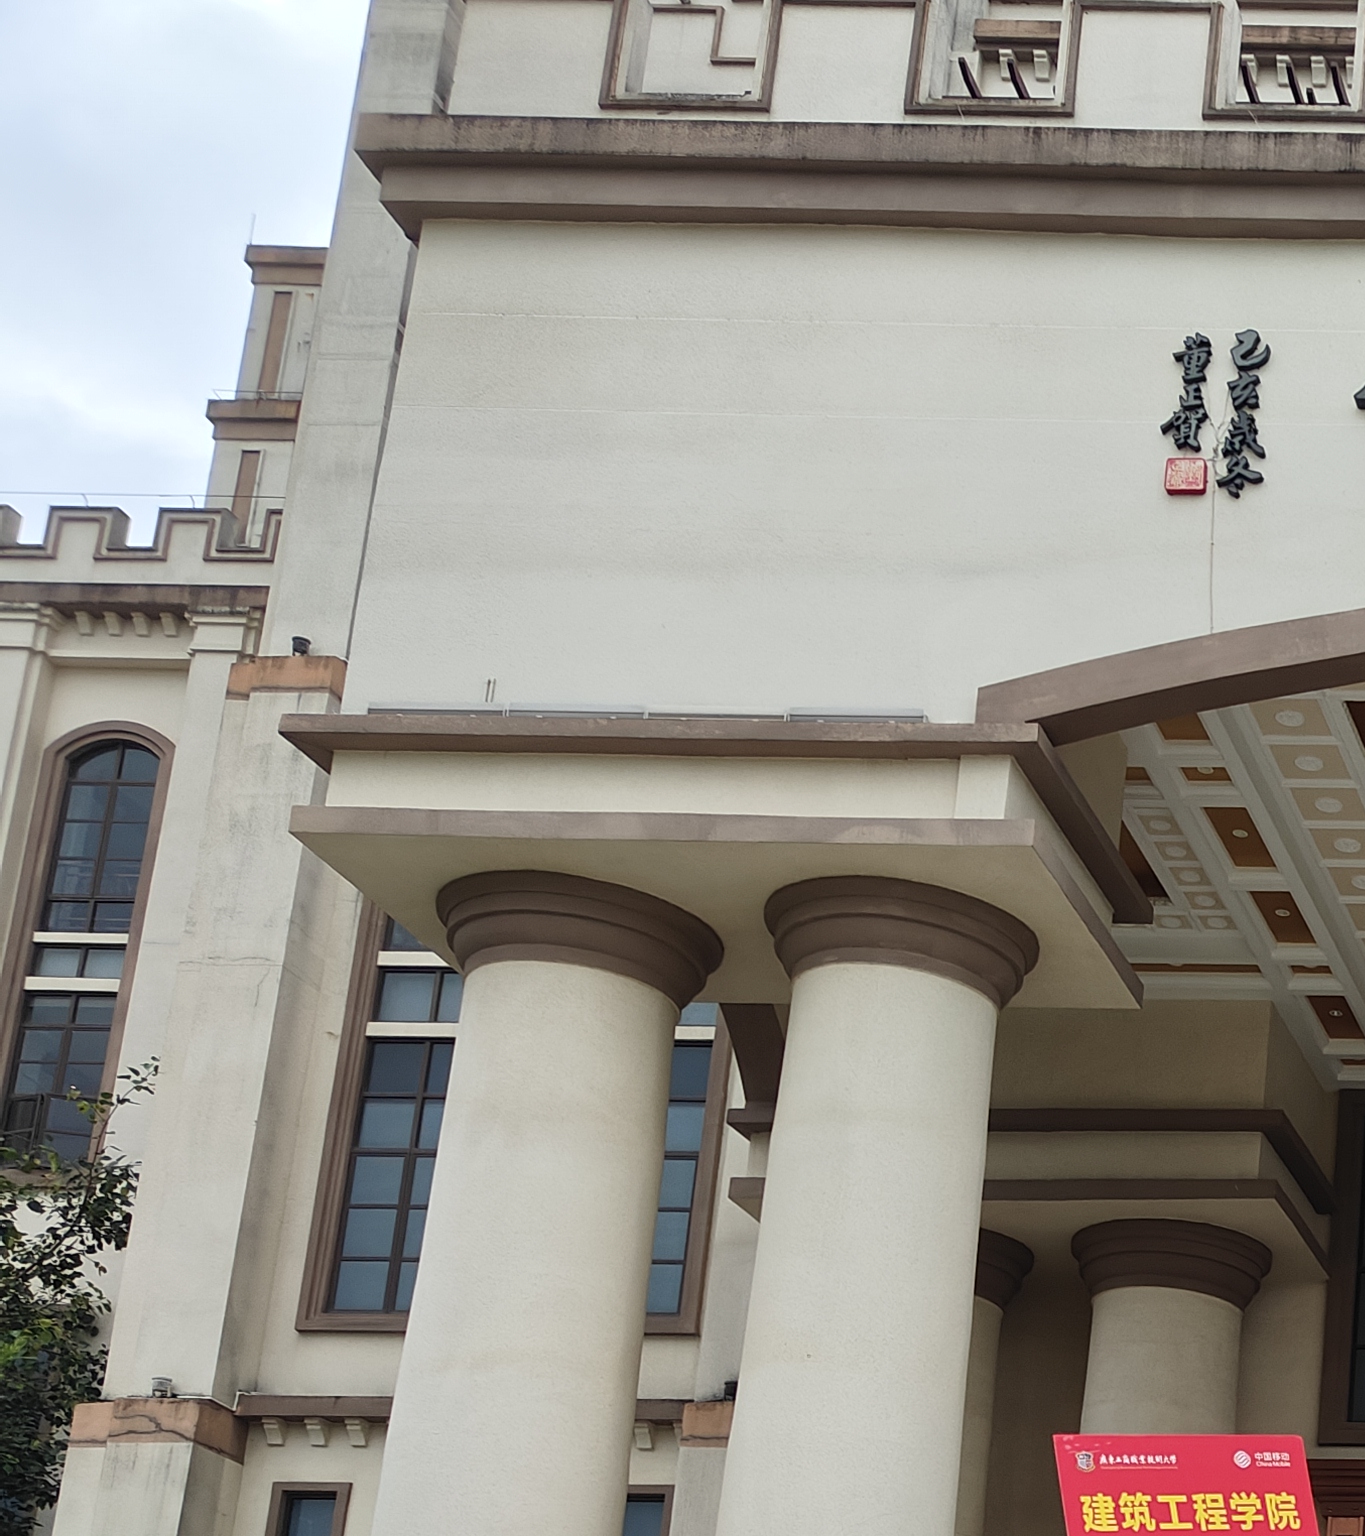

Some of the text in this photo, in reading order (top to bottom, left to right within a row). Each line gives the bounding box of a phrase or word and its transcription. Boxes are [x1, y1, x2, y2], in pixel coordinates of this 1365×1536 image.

[1254, 1451, 1290, 1461] 中国移动
[1080, 1491, 1301, 1532] 建筑工程学院
